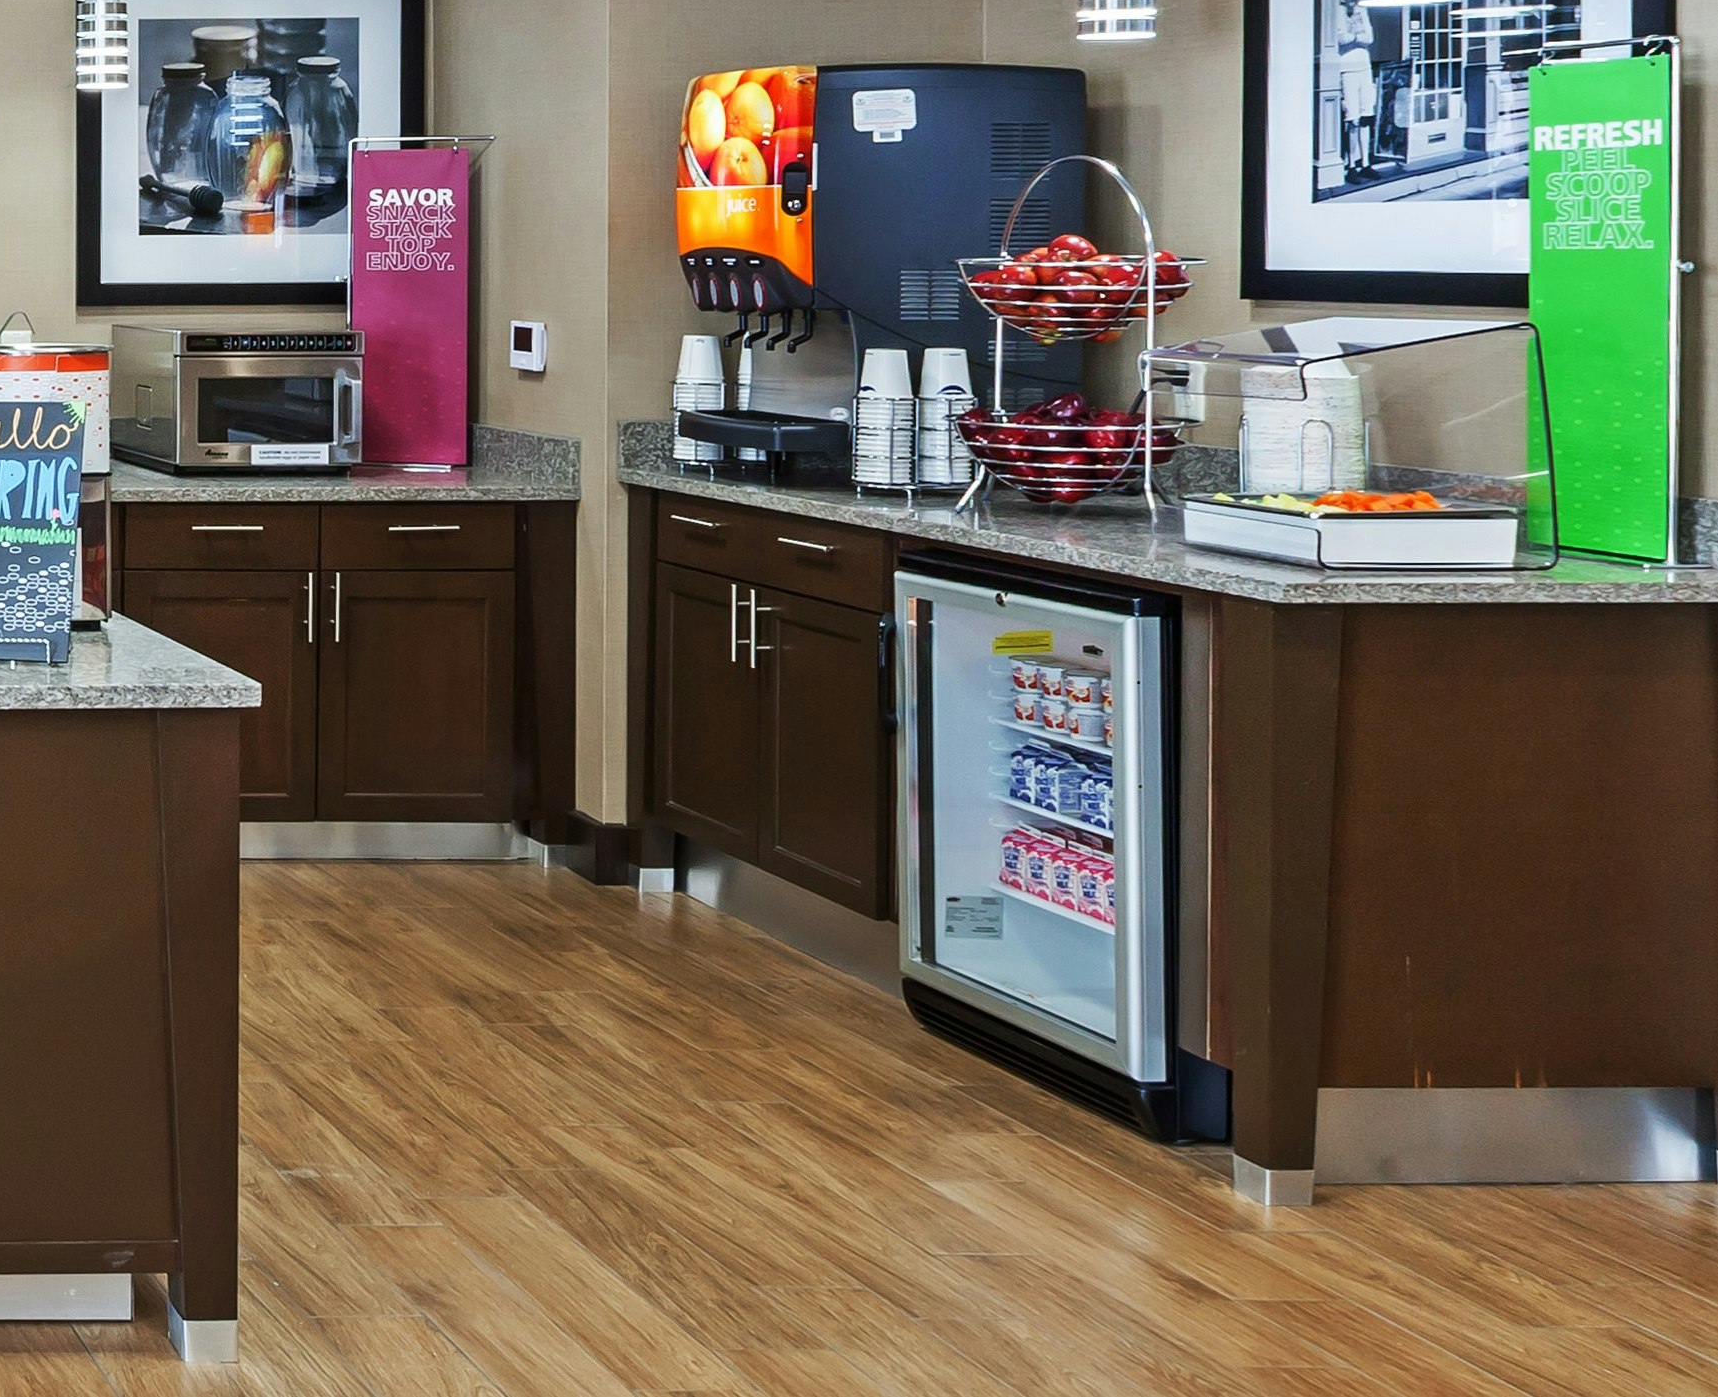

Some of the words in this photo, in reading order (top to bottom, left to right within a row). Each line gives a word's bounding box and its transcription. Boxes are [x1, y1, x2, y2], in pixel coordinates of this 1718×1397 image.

[1533, 118, 1663, 151] REFRESH
[1561, 146, 1636, 173] PEEL
[1545, 169, 1652, 200] SCOOP
[369, 188, 454, 206] SAVOR
[366, 204, 456, 222] SNACK
[1555, 195, 1642, 224] SLICE
[369, 220, 453, 238] STACK
[1543, 220, 1655, 250] RELAX.
[385, 236, 436, 254] TOP
[366, 252, 455, 271] ENJOY.
